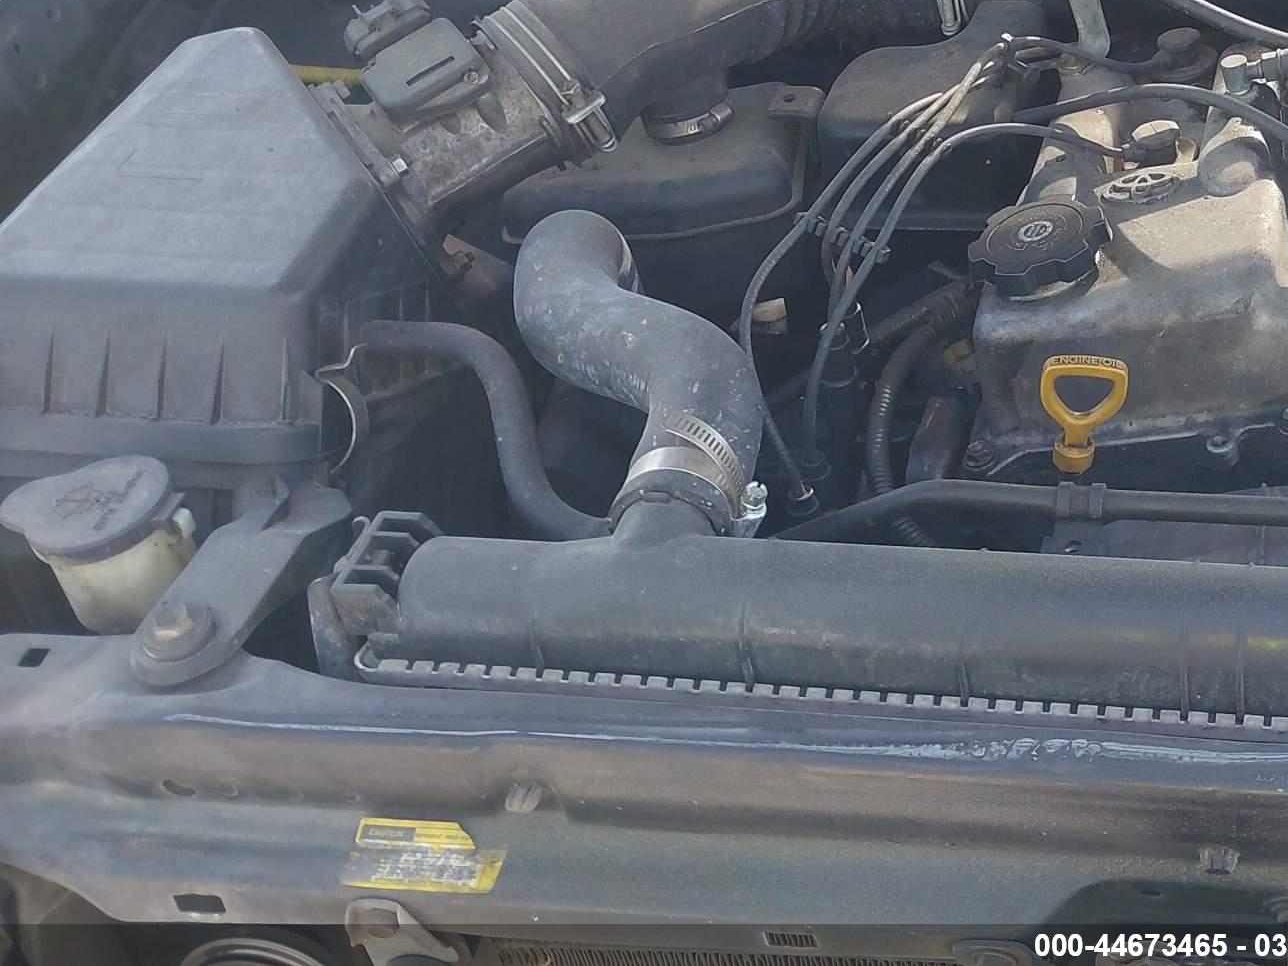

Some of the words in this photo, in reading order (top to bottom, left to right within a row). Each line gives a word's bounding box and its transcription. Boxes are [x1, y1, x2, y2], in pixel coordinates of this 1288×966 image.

[1051, 355, 1099, 365] ENGINE
[1101, 358, 1124, 369] OIL
[368, 826, 405, 838] CAUTION
